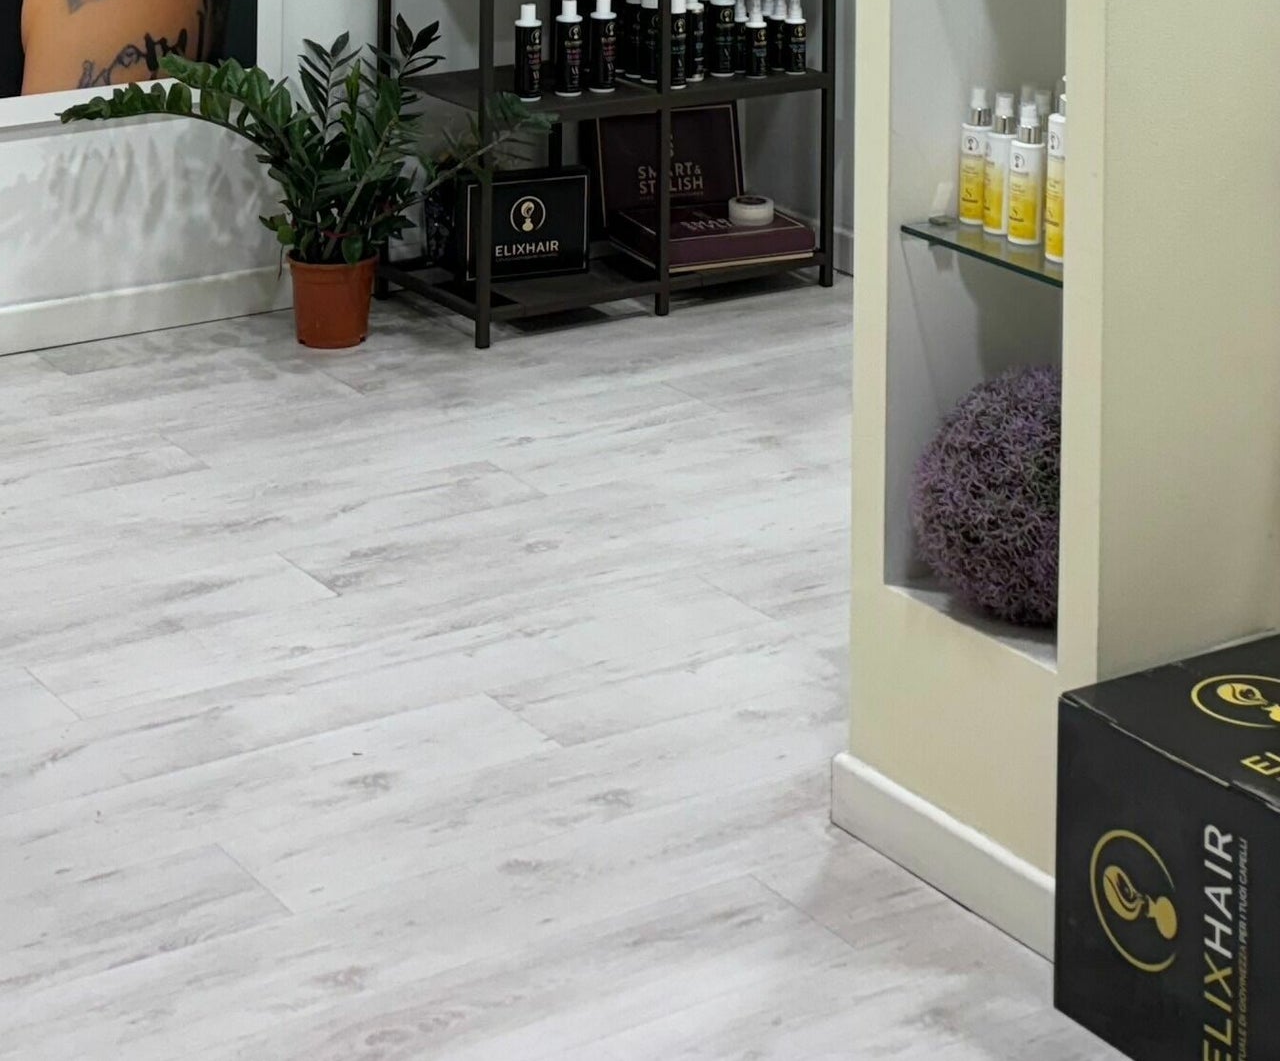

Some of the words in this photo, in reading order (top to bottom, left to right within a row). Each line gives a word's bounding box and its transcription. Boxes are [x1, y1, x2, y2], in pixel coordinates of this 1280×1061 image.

[638, 162, 693, 180] SMRT
[639, 176, 704, 195] STLISH
[495, 239, 559, 258] ELIXHAIR
[1238, 922, 1248, 944] PER
